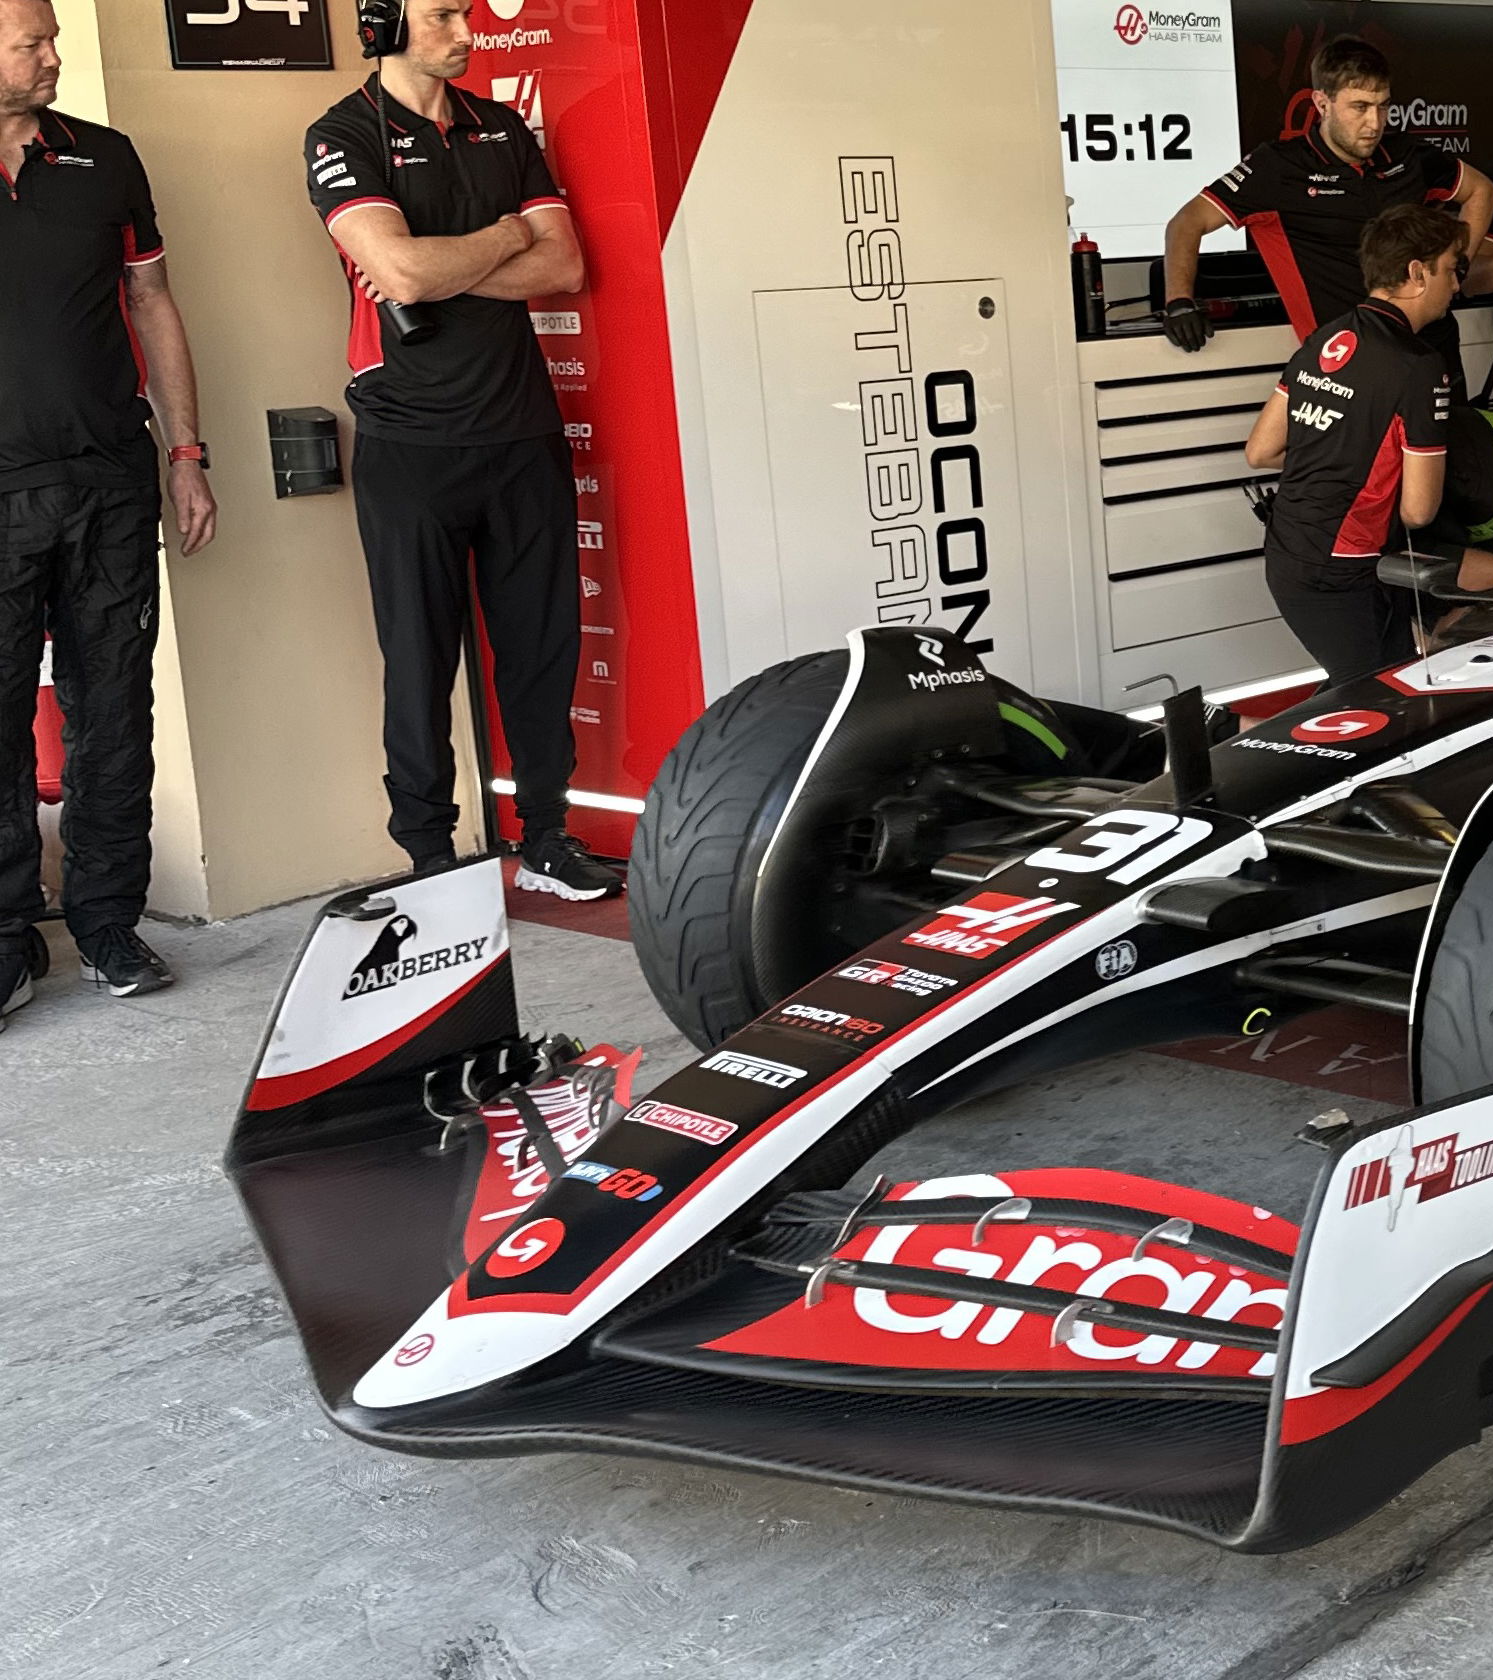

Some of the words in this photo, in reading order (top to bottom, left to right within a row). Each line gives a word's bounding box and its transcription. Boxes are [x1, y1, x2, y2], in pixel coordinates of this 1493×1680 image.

[1148, 11, 1221, 30] MoneyGram
[473, 28, 552, 52] MoneyGram
[1149, 33, 1178, 42] HAAS
[1193, 34, 1222, 43] TEAM
[1386, 98, 1468, 130] eyGram
[1060, 113, 1193, 163] 15:12
[534, 315, 577, 330] IPOTLE
[1297, 370, 1354, 399] MoneyGram
[1291, 401, 1344, 431] HAAS
[924, 369, 995, 652] OCON
[908, 667, 985, 692] Mphasis
[1231, 738, 1357, 761] MoneyGram
[1025, 809, 1213, 885] 31
[902, 930, 1008, 954] HAAS
[345, 936, 488, 996] OAKBERRY
[837, 966, 892, 985] GR
[906, 968, 959, 987] TOYOTA
[892, 975, 944, 990] GAZOO
[699, 1051, 807, 1088] PIRELLI
[650, 1107, 730, 1139] CHIPOTLE
[1415, 1135, 1454, 1180] HAAS
